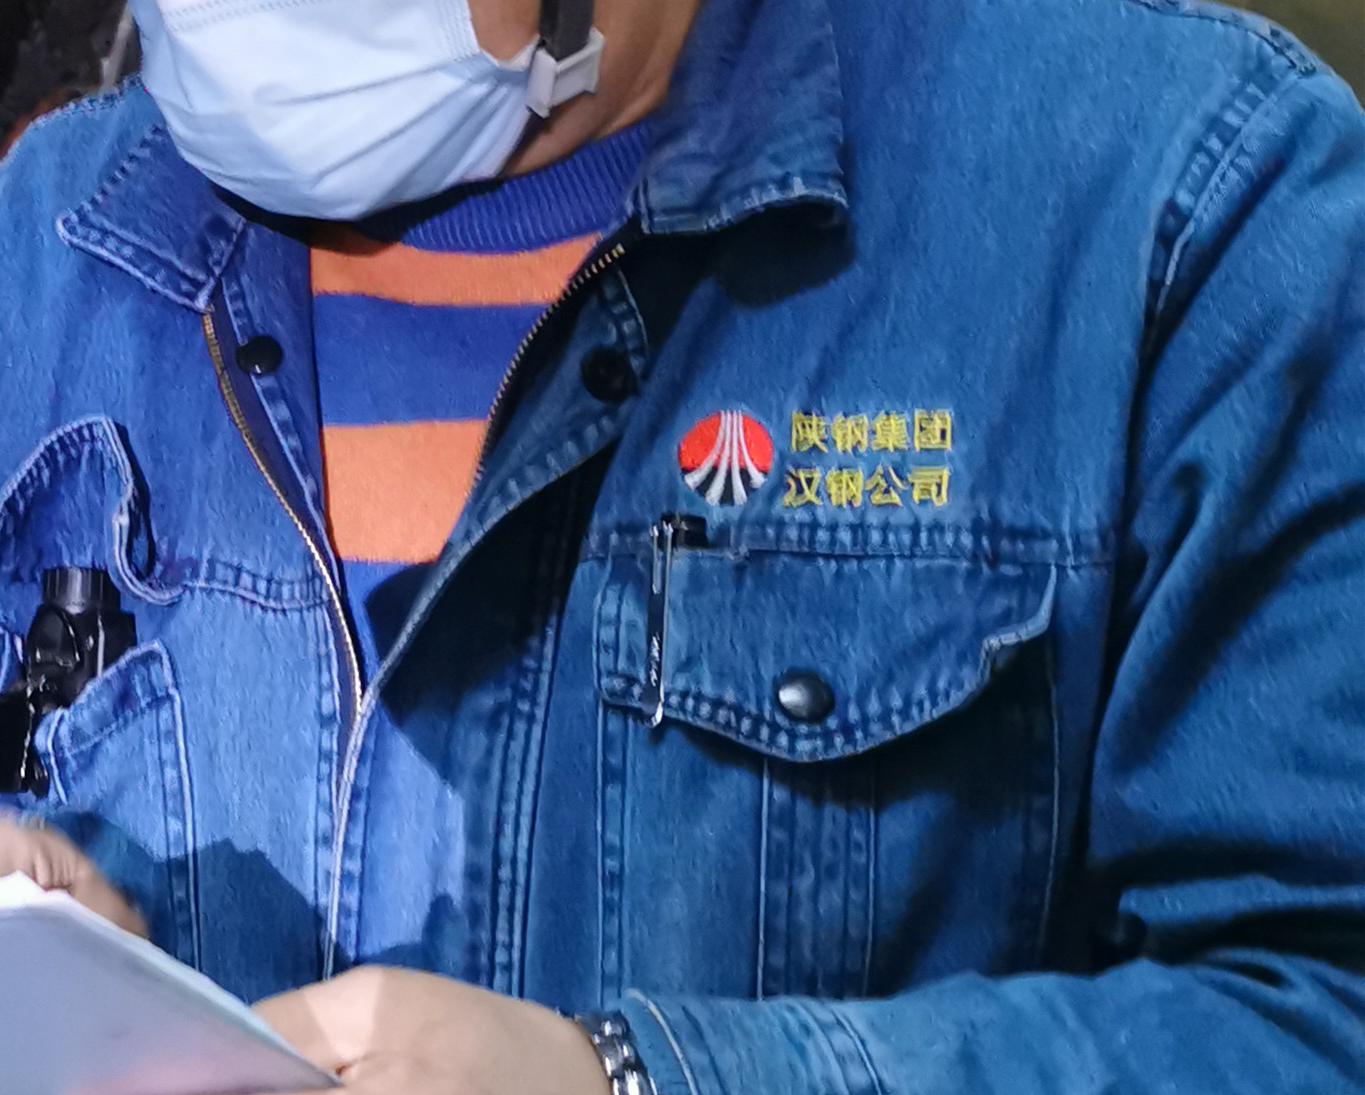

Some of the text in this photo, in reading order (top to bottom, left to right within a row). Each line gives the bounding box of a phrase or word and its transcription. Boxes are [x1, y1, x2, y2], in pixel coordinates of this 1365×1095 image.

[791, 409, 952, 453] 陕钢集团
[783, 465, 950, 507] 汉钢公司
